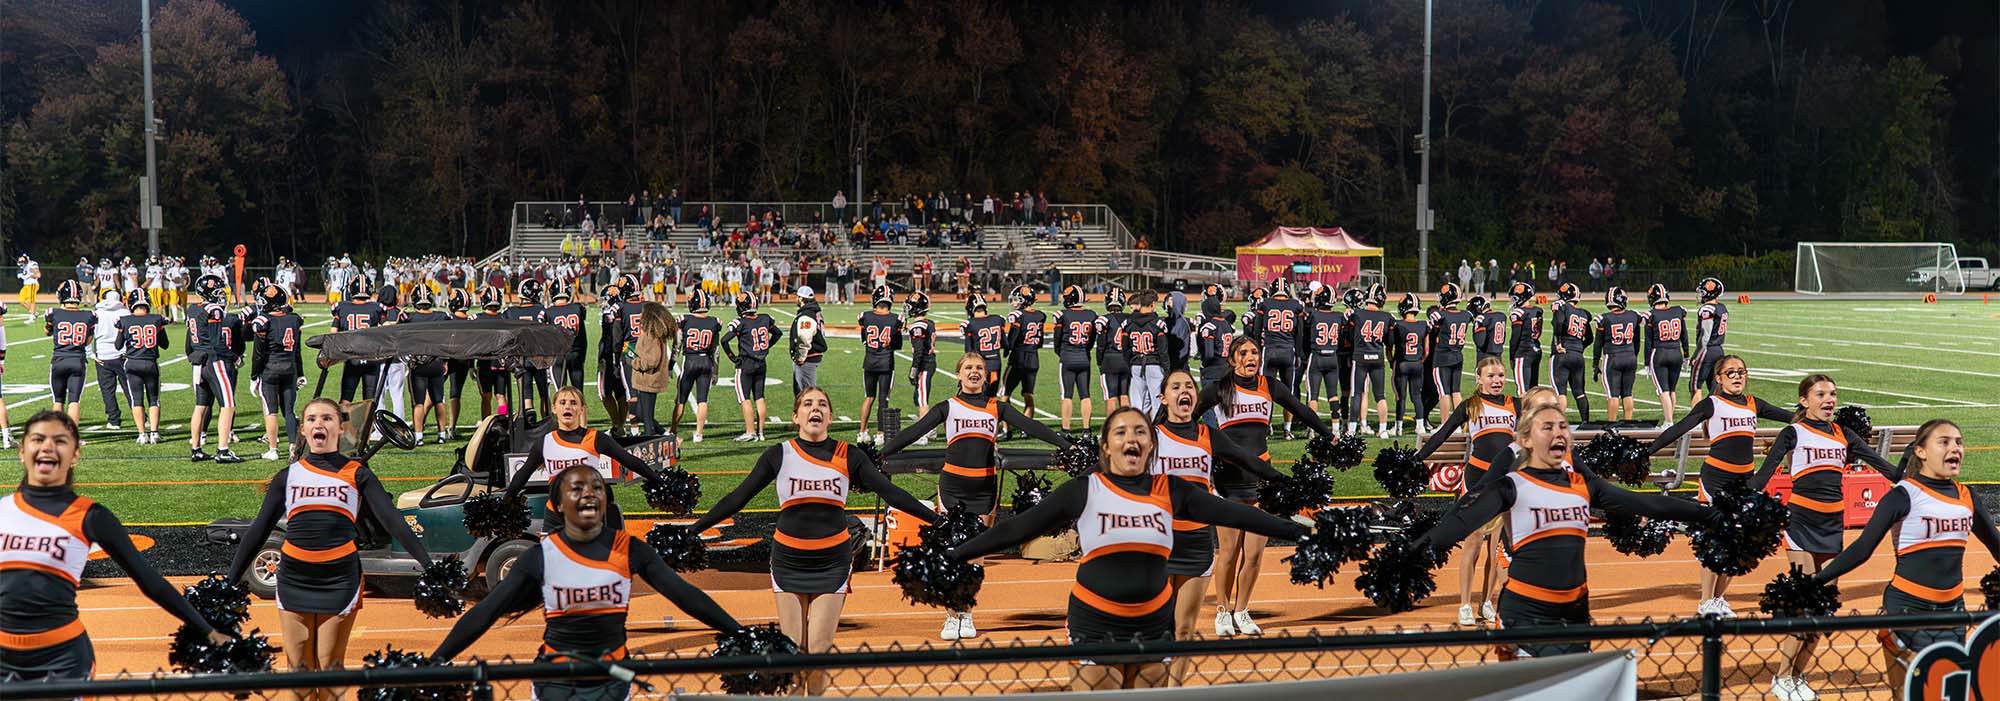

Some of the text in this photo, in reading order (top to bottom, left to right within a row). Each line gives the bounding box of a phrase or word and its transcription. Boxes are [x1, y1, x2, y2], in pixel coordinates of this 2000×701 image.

[1538, 295, 1547, 304] 20
[1267, 309, 1294, 332] 26
[1360, 319, 1385, 343] 44
[1567, 313, 1588, 339] 65
[1658, 318, 1681, 343] 88
[57, 322, 87, 346] 28
[128, 324, 157, 349] 38
[282, 327, 295, 352] 4
[687, 328, 713, 352] 20
[751, 326, 770, 351] 13
[866, 325, 891, 349] 24
[978, 325, 1001, 352] 27
[1068, 324, 1092, 347] 39
[1129, 331, 1155, 355] 30
[1316, 322, 1339, 346] 34
[1405, 332, 1418, 356] 2
[1448, 322, 1467, 346] 14
[1611, 322, 1634, 347] 54
[954, 417, 996, 434] TIGERS
[1478, 414, 1516, 430] TIGERS
[1721, 416, 1757, 432] TIGERS
[1158, 454, 1209, 474] TIGERS
[1803, 447, 1848, 466] TIGERS
[291, 485, 349, 504] TIGERS
[789, 477, 842, 497] TIGERS
[1097, 511, 1167, 536] TIGERS
[552, 581, 622, 610] TIGERS
